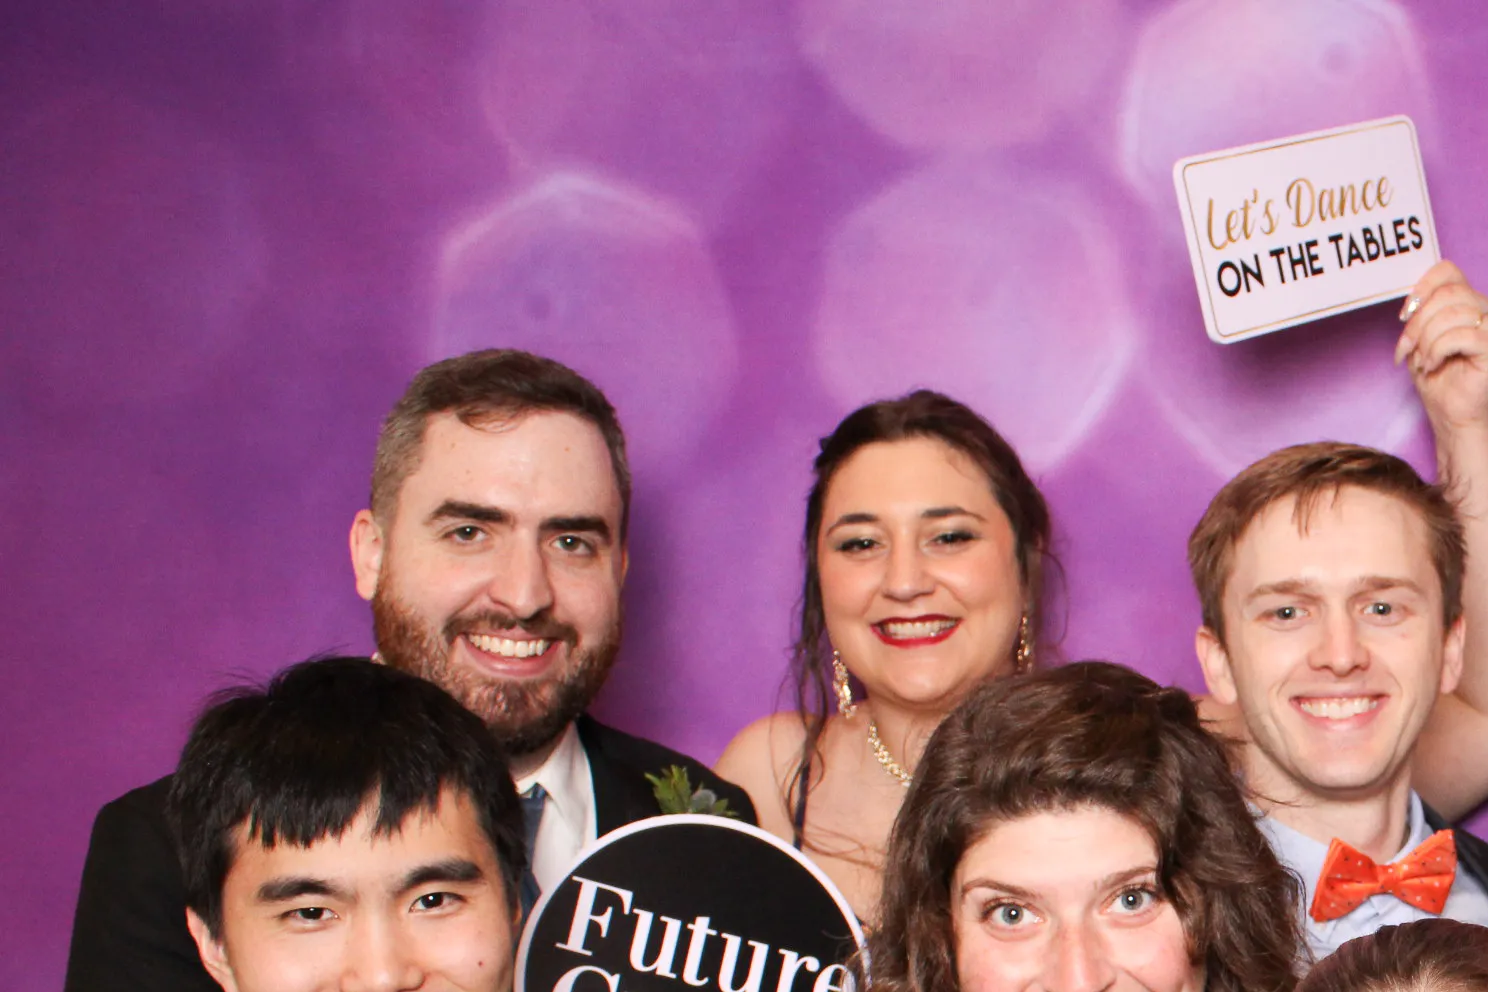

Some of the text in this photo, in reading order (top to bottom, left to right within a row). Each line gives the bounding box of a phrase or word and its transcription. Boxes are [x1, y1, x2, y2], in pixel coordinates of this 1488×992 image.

[1207, 176, 1393, 250] Let's Dance
[1217, 216, 1423, 297] ON THE TABLES
